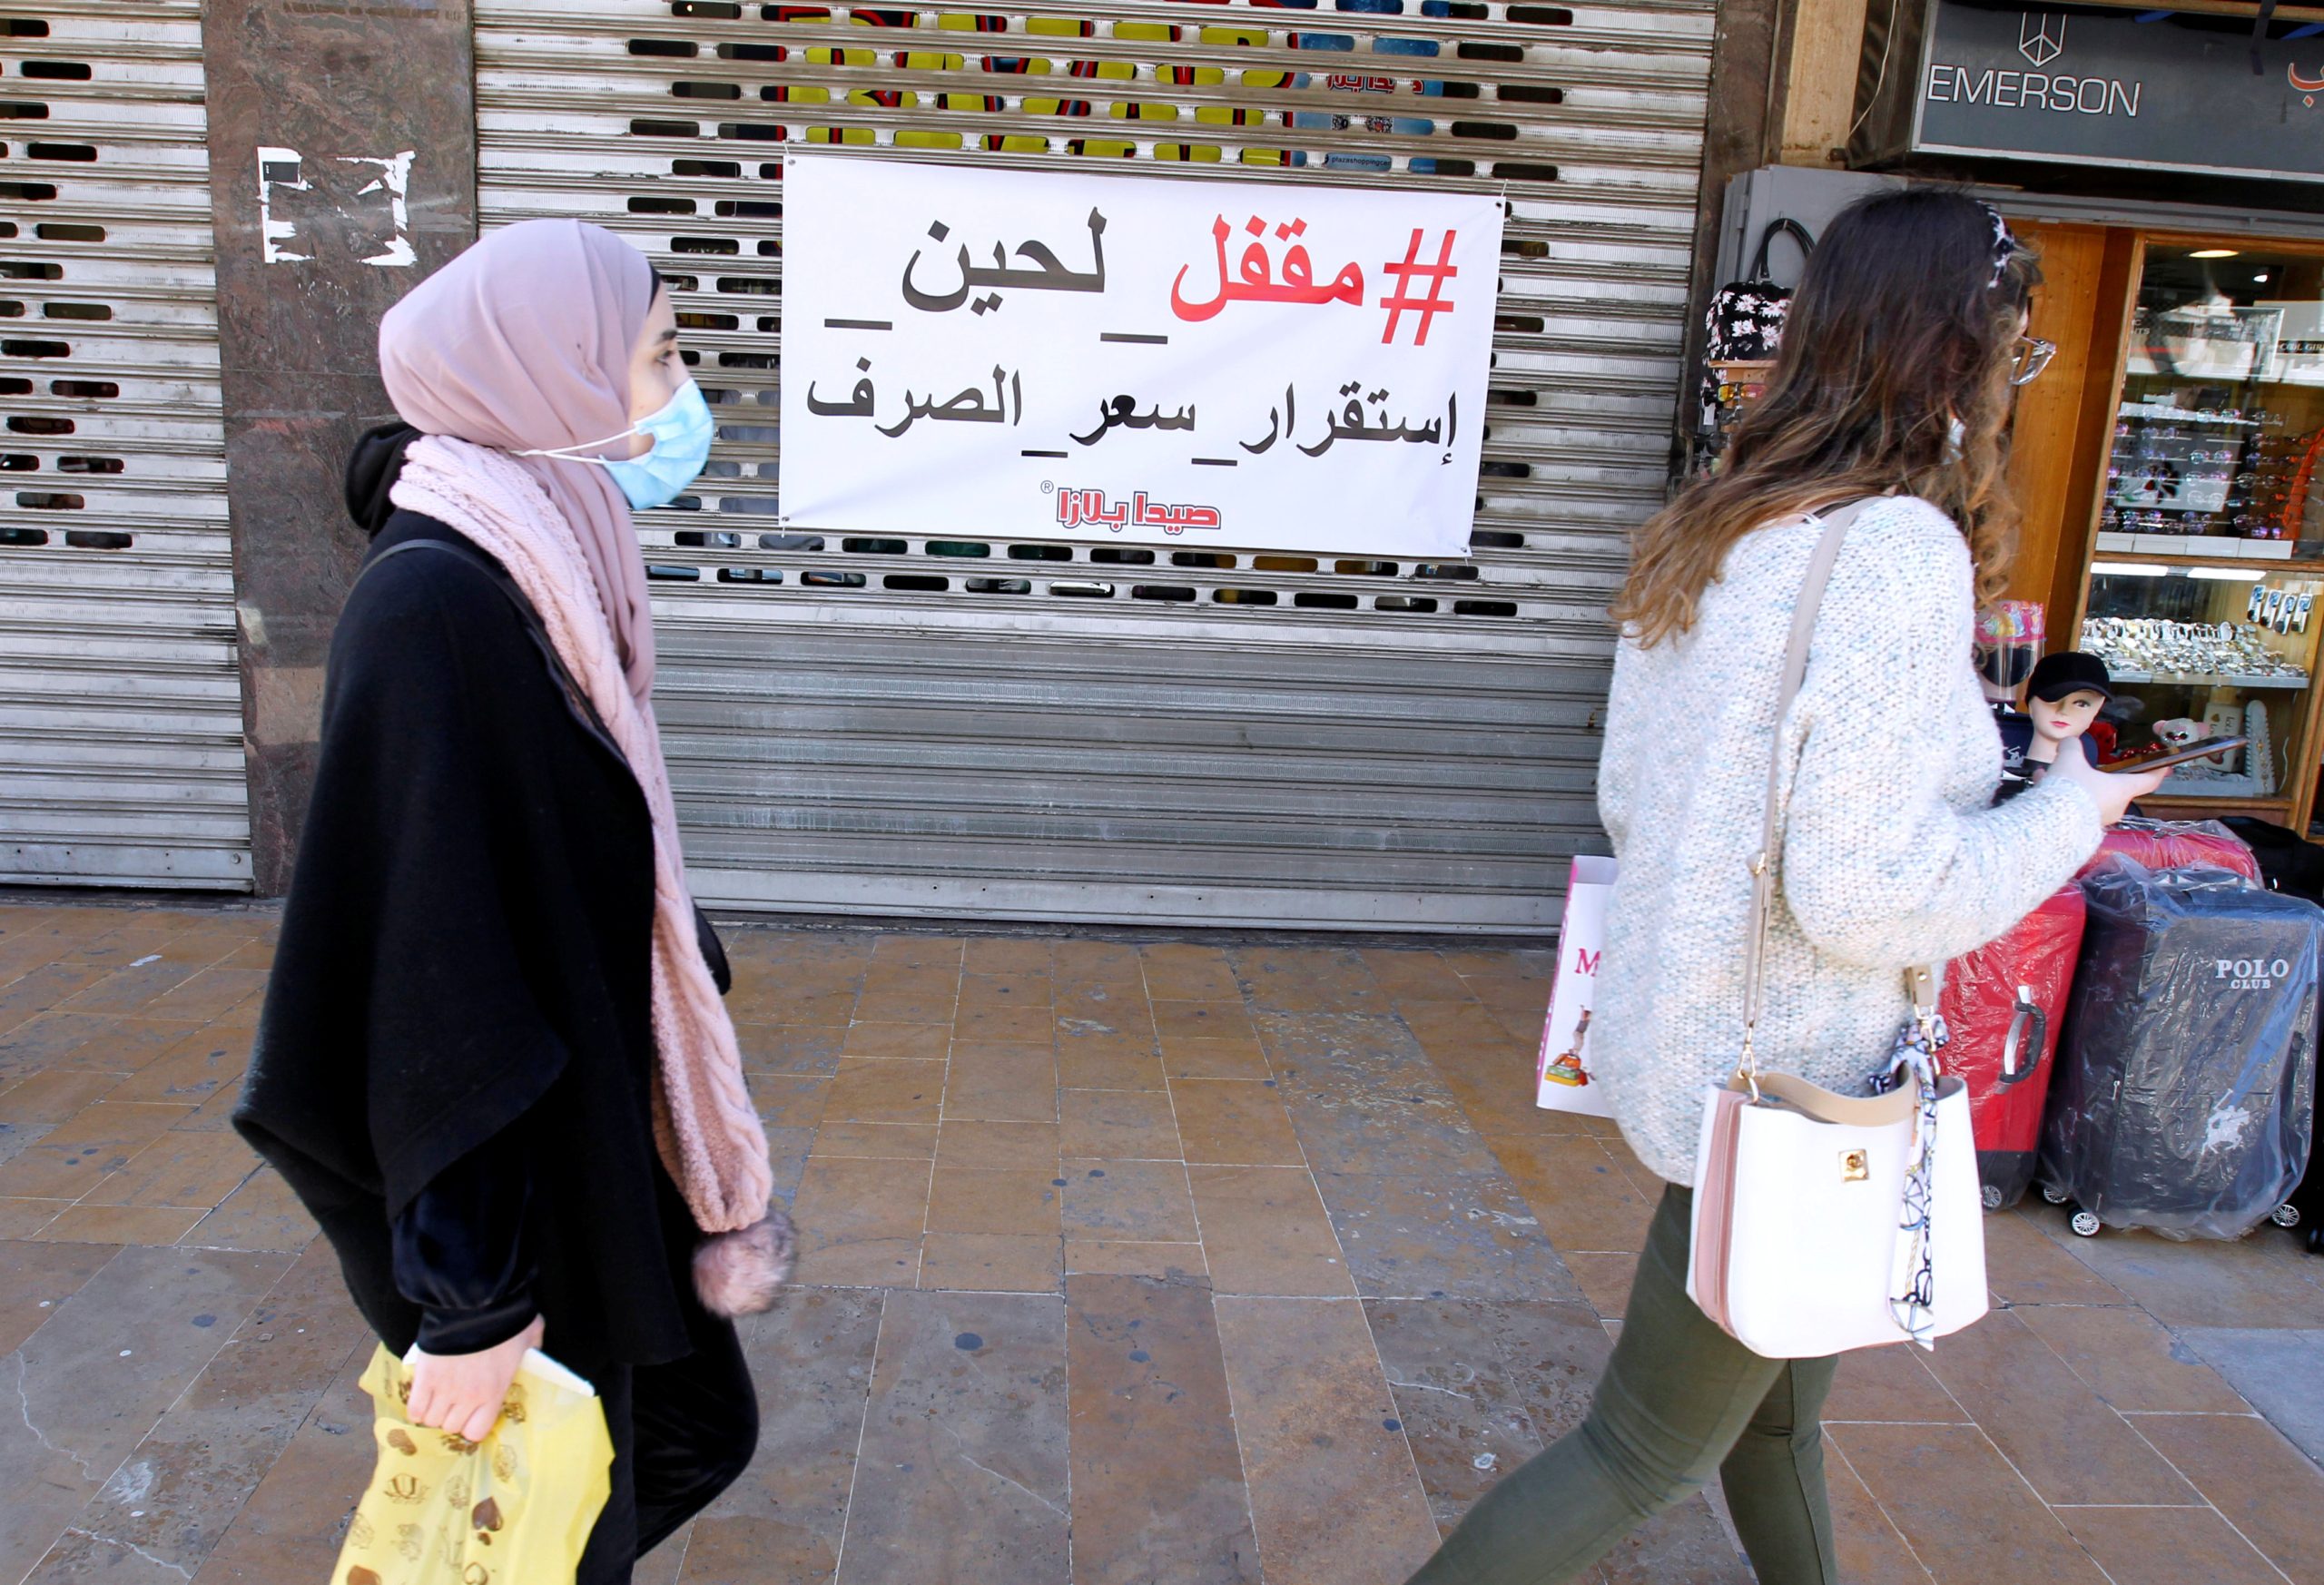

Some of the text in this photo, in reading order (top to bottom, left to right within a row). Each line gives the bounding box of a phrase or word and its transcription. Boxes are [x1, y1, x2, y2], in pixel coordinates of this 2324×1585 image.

[1926, 64, 2142, 117] EMERSON
[1056, 487, 1129, 533] بلازا
[1132, 491, 1222, 536] صيدا
[2215, 958, 2290, 979] POLO
[2230, 979, 2271, 989] CLUB
